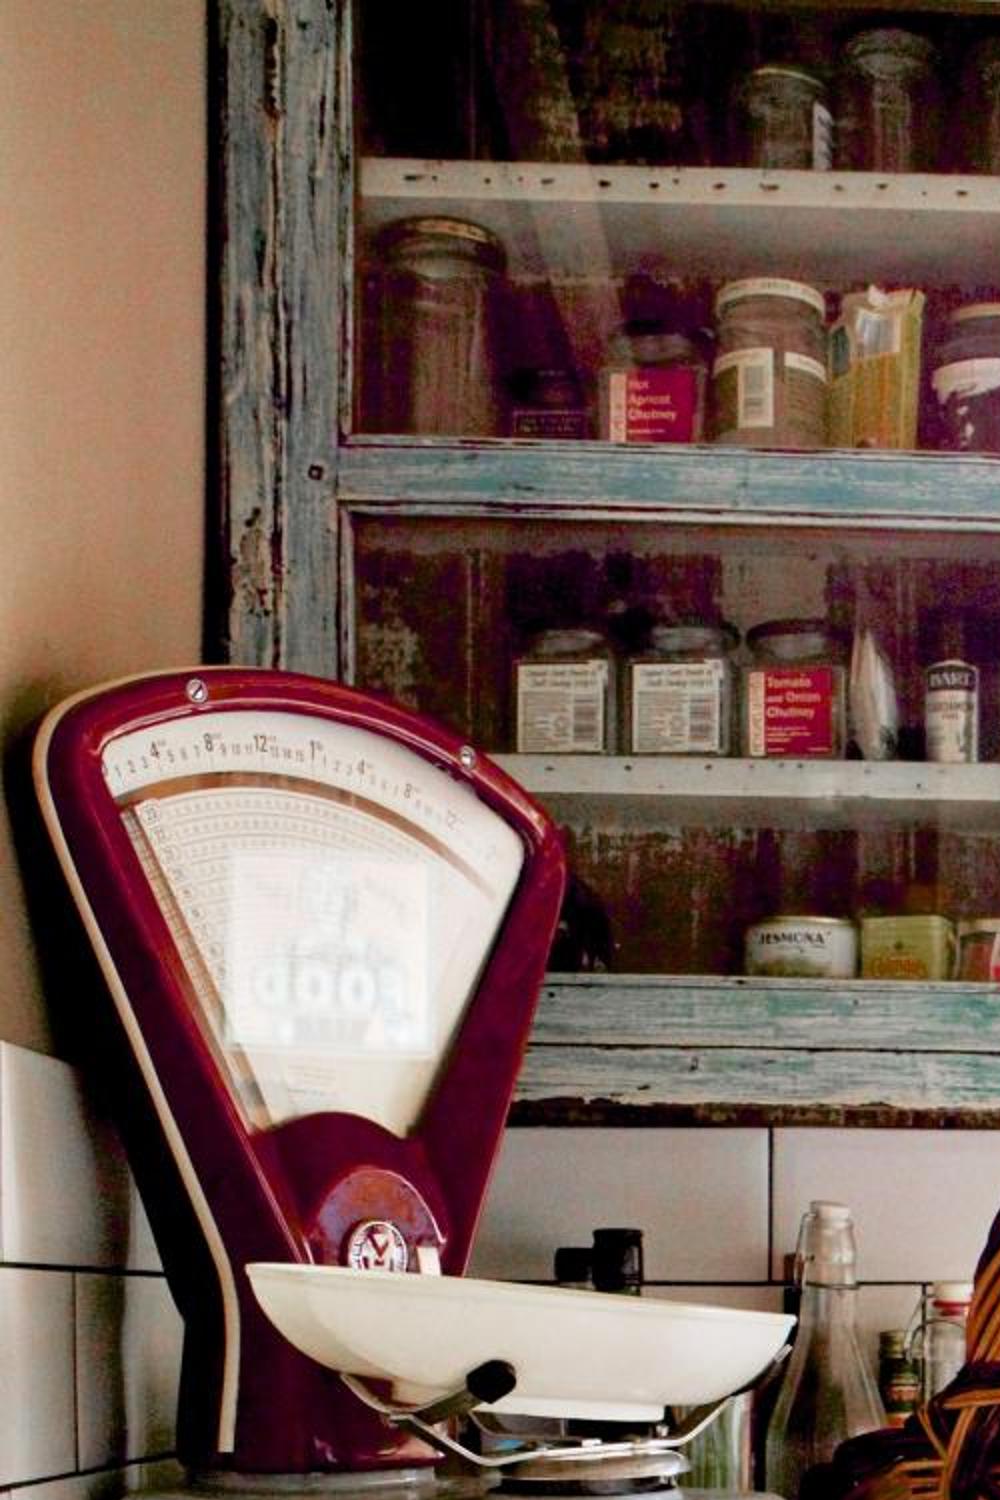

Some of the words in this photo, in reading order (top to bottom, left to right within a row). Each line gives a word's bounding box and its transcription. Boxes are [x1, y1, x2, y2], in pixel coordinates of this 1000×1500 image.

[767, 676, 812, 688] Tomato
[785, 691, 822, 703] Onion
[767, 706, 816, 720] Chutney
